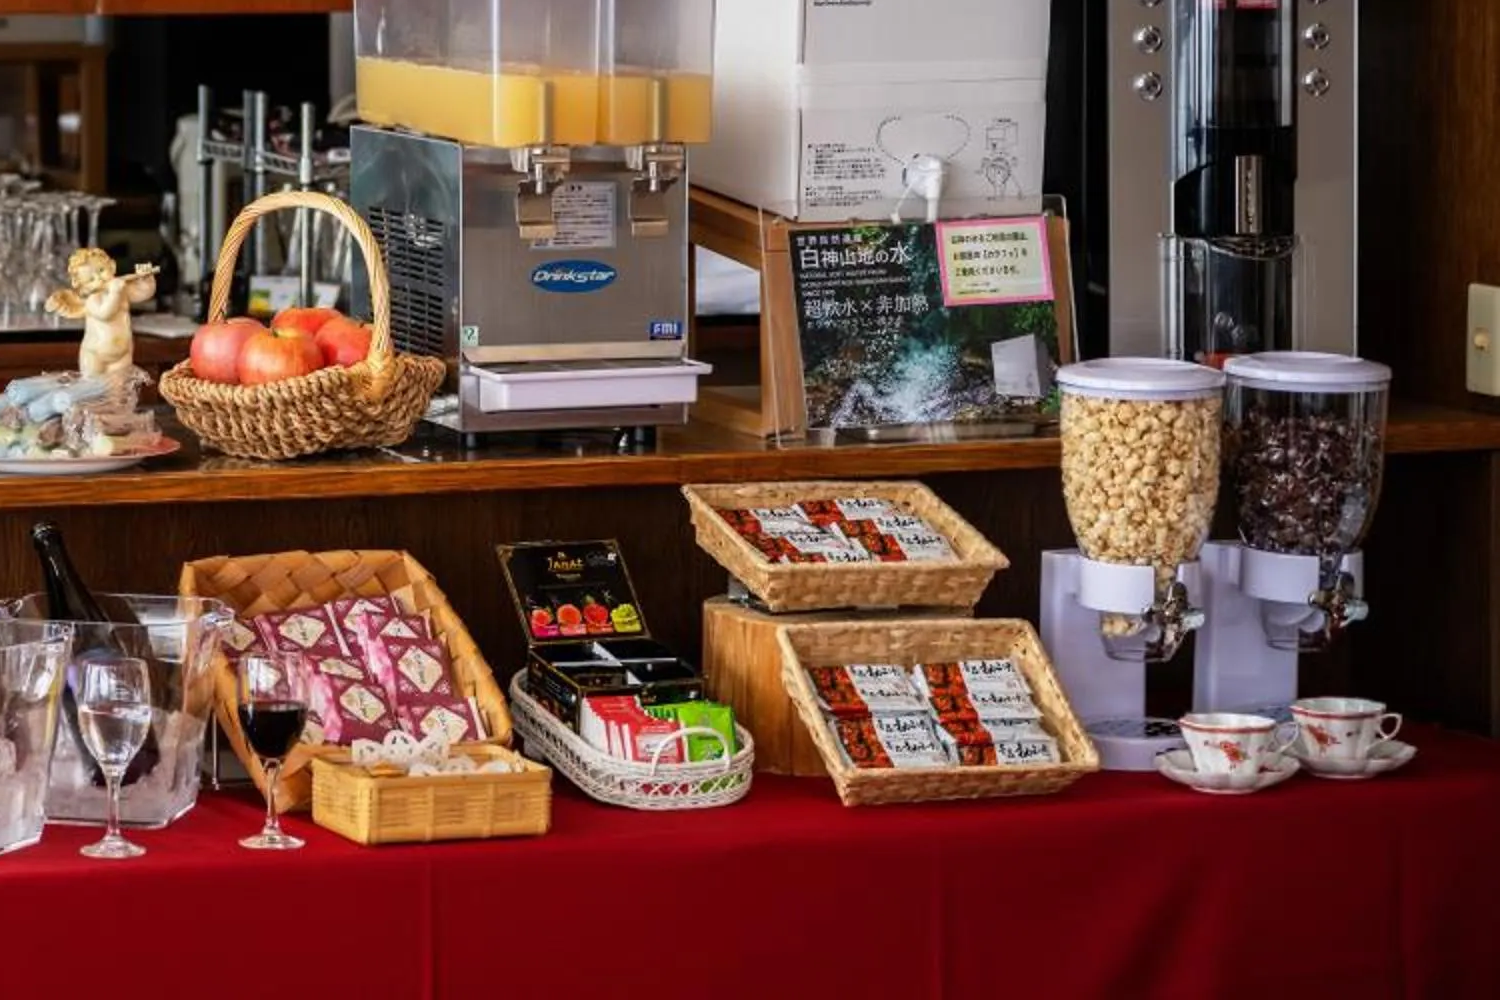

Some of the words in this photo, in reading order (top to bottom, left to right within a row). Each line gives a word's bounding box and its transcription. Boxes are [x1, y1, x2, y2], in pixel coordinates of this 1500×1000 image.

[800, 240, 914, 269] 白神山地の水
[534, 267, 614, 283] Drinkstar
[653, 323, 678, 335] FMI
